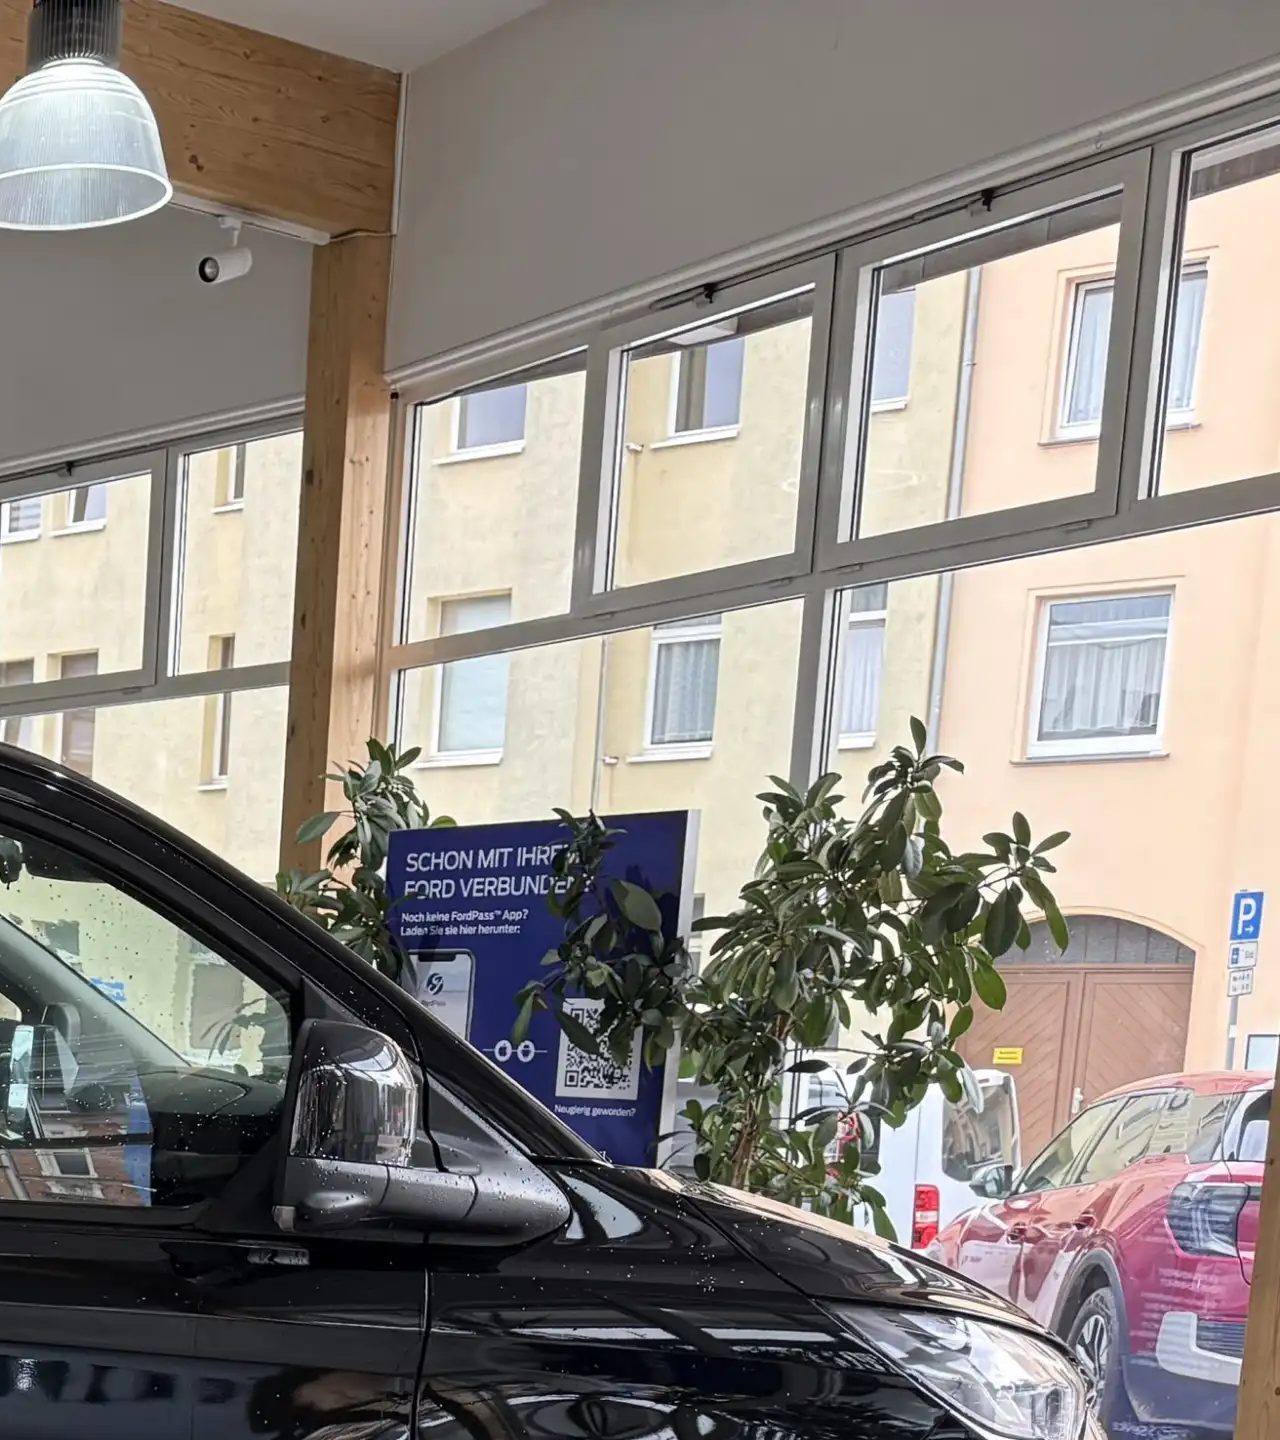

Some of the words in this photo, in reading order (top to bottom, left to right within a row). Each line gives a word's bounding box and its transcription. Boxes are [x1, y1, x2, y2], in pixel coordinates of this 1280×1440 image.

[405, 849, 474, 872] SCHON
[477, 847, 514, 869] MIT
[404, 879, 456, 900] FORD
[401, 912, 425, 923] Noch
[426, 911, 450, 922] keine
[502, 909, 529, 922] App?
[1237, 898, 1257, 935] P
[400, 925, 428, 936] Laden
[444, 925, 459, 935] sie
[459, 924, 477, 935] hier
[478, 923, 521, 935] herunter:
[555, 1104, 591, 1116] Neugierig
[591, 1107, 637, 1117] geworden?
